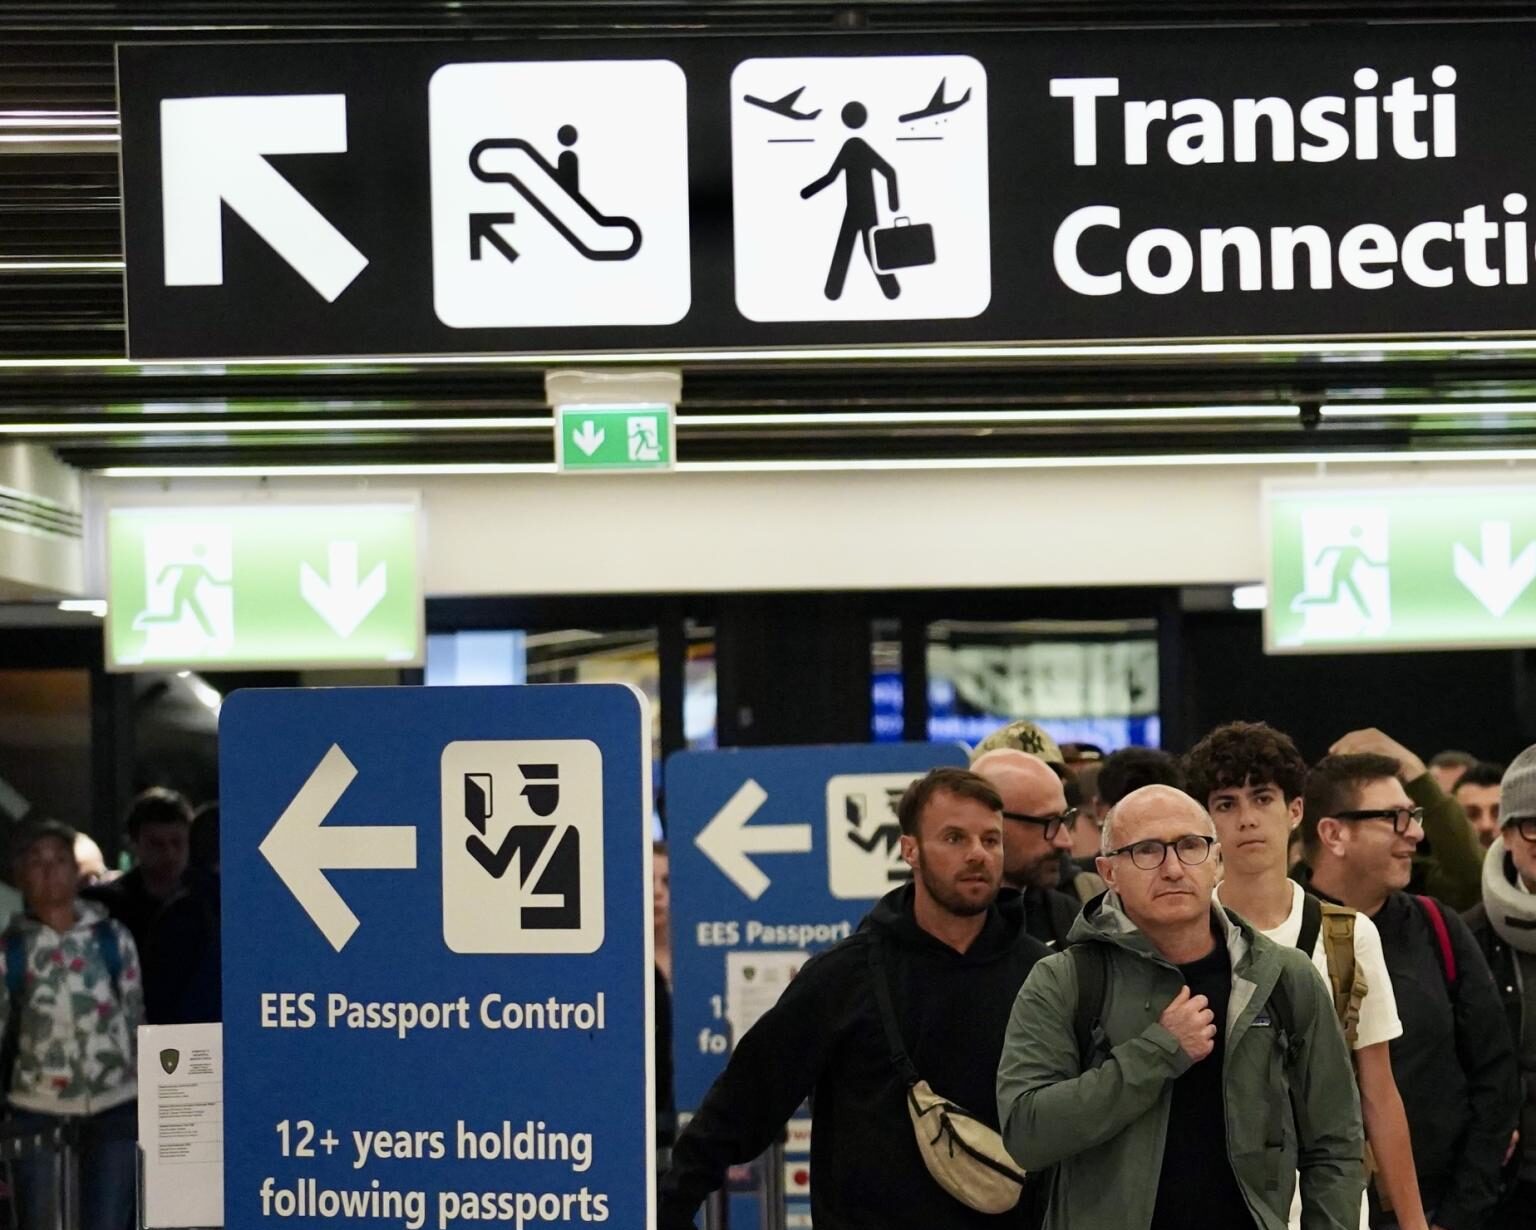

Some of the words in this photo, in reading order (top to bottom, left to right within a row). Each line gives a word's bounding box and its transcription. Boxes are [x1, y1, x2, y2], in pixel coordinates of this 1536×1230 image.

[1049, 64, 1457, 166] Transiti
[696, 920, 740, 947] EES
[745, 920, 852, 949] Passport
[261, 992, 316, 1028] EES
[328, 993, 470, 1039] Passport
[480, 991, 605, 1030] Control
[275, 1119, 340, 1159] 12+
[353, 1130, 446, 1169] years
[457, 1119, 593, 1172] holding
[259, 1177, 426, 1230] following
[438, 1186, 609, 1230] passports
